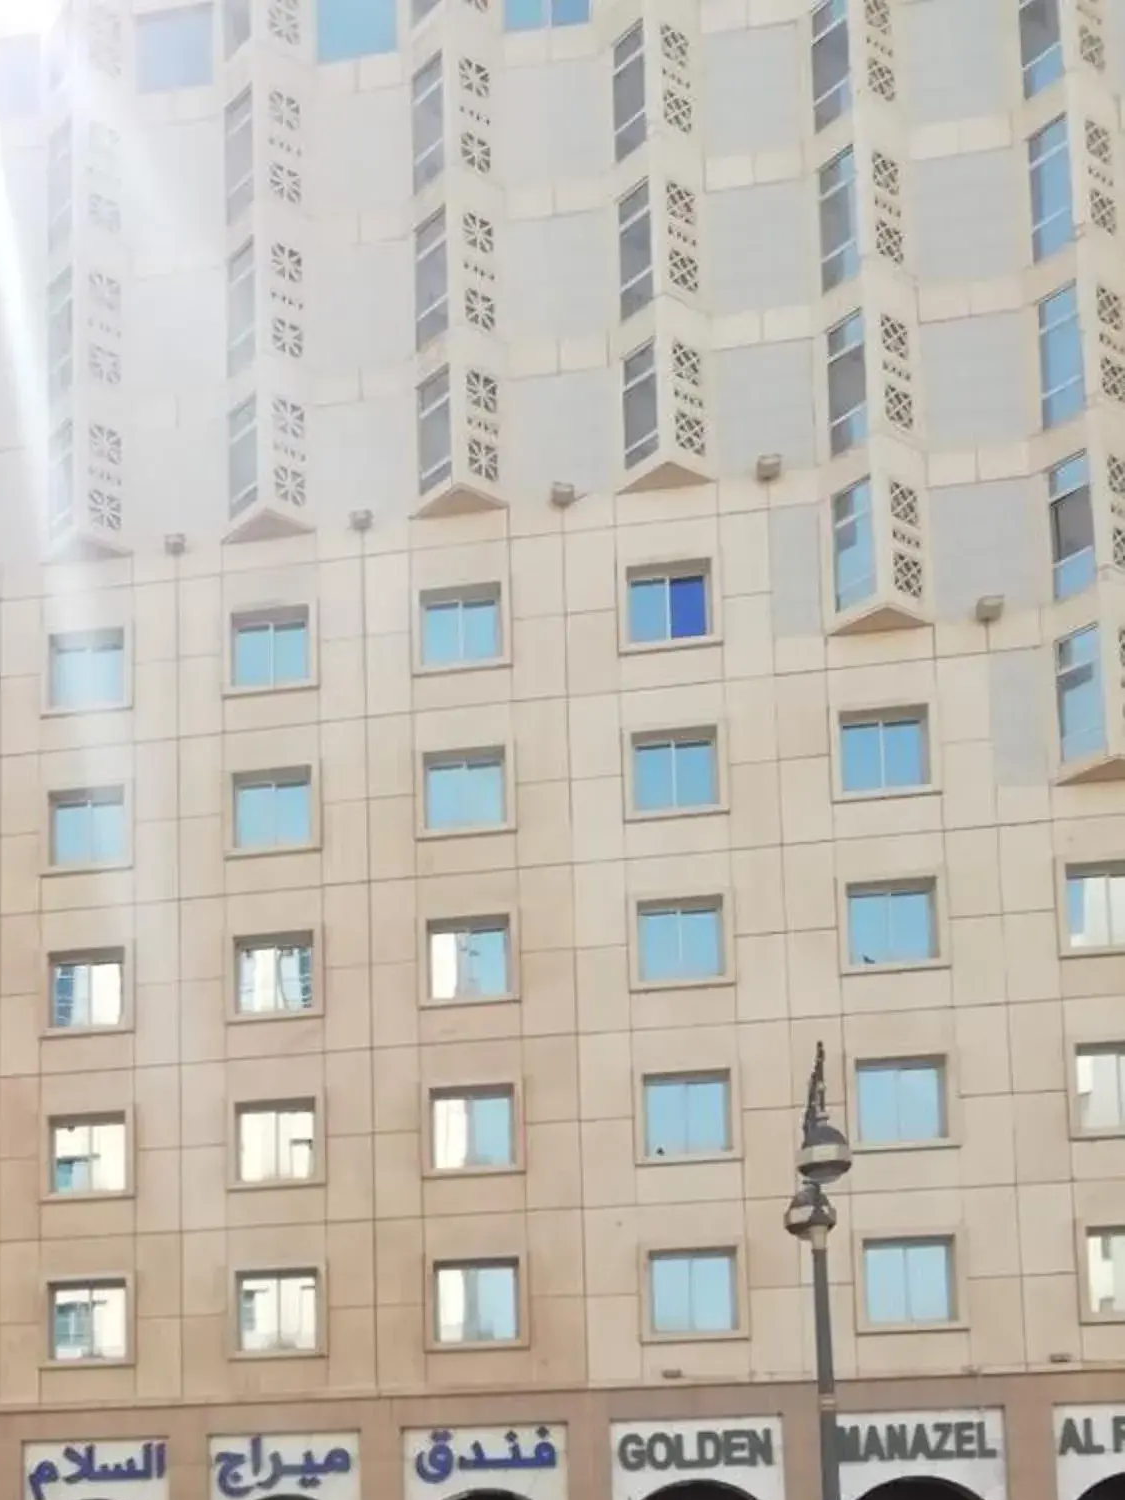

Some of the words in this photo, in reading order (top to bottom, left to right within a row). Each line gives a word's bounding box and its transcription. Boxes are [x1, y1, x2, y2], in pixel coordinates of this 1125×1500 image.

[214, 1435, 352, 1499] ميراج
[415, 1426, 557, 1484] فندق
[618, 1428, 774, 1471] GOLDEN
[1058, 1417, 1105, 1456] AL
